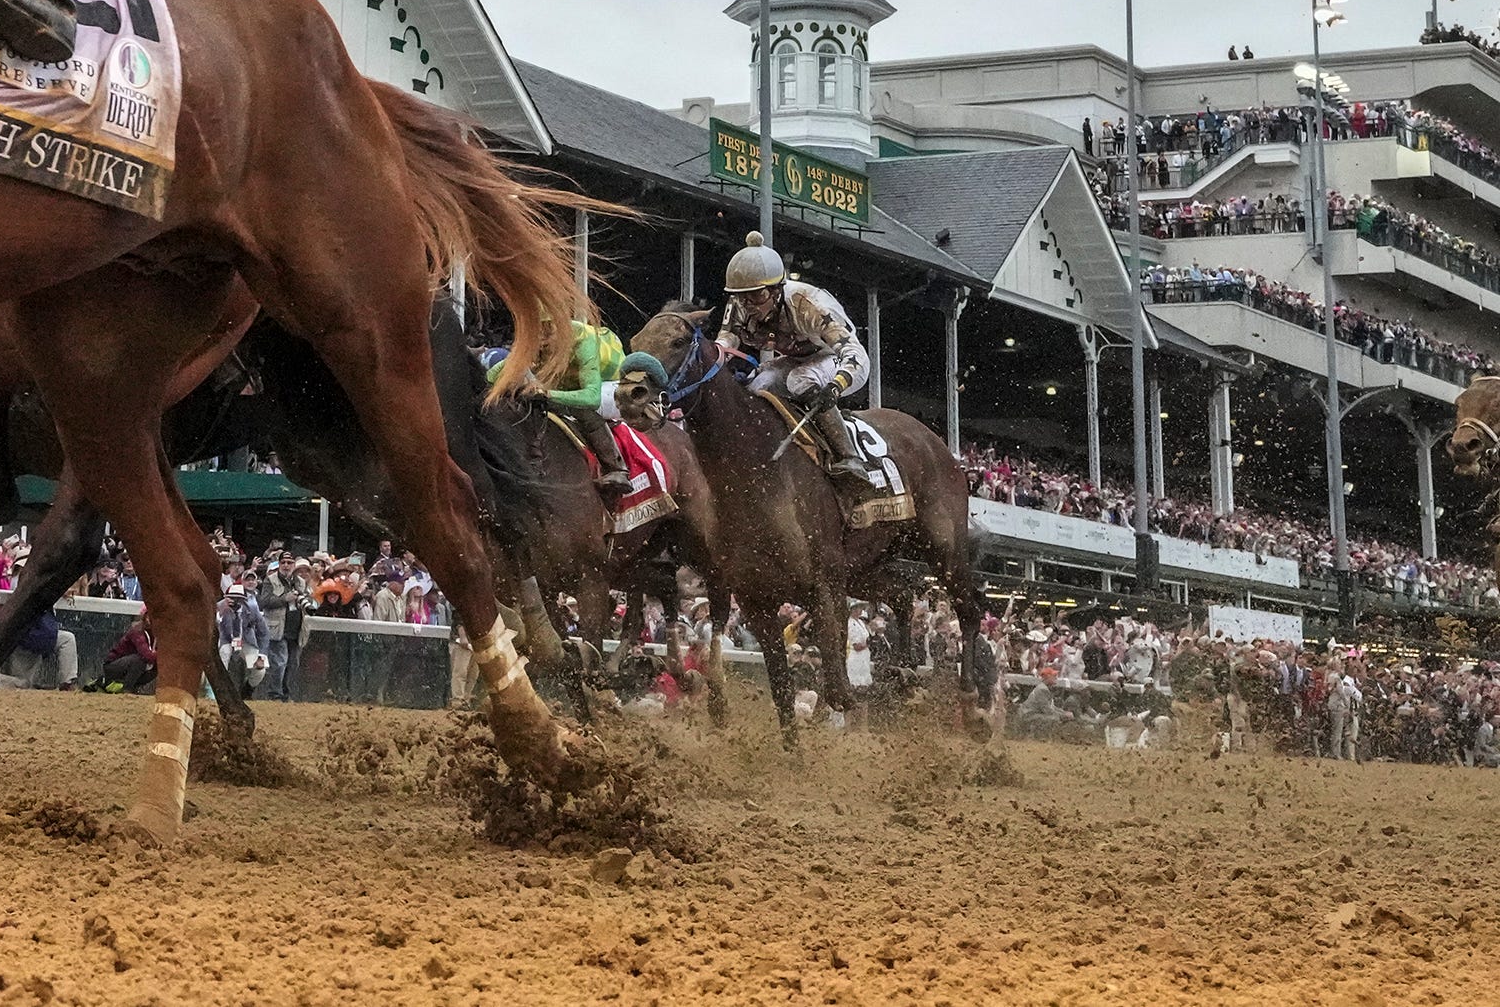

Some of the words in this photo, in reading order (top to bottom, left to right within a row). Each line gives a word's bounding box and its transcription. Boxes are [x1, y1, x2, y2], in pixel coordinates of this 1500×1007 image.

[110, 81, 151, 104] KENTUCKY
[105, 92, 157, 140] DERBY
[24, 132, 144, 199] STRIKE
[717, 132, 747, 154] FIRST
[749, 143, 780, 166] DEY
[811, 182, 858, 214] 2022
[831, 173, 864, 195] DERBY
